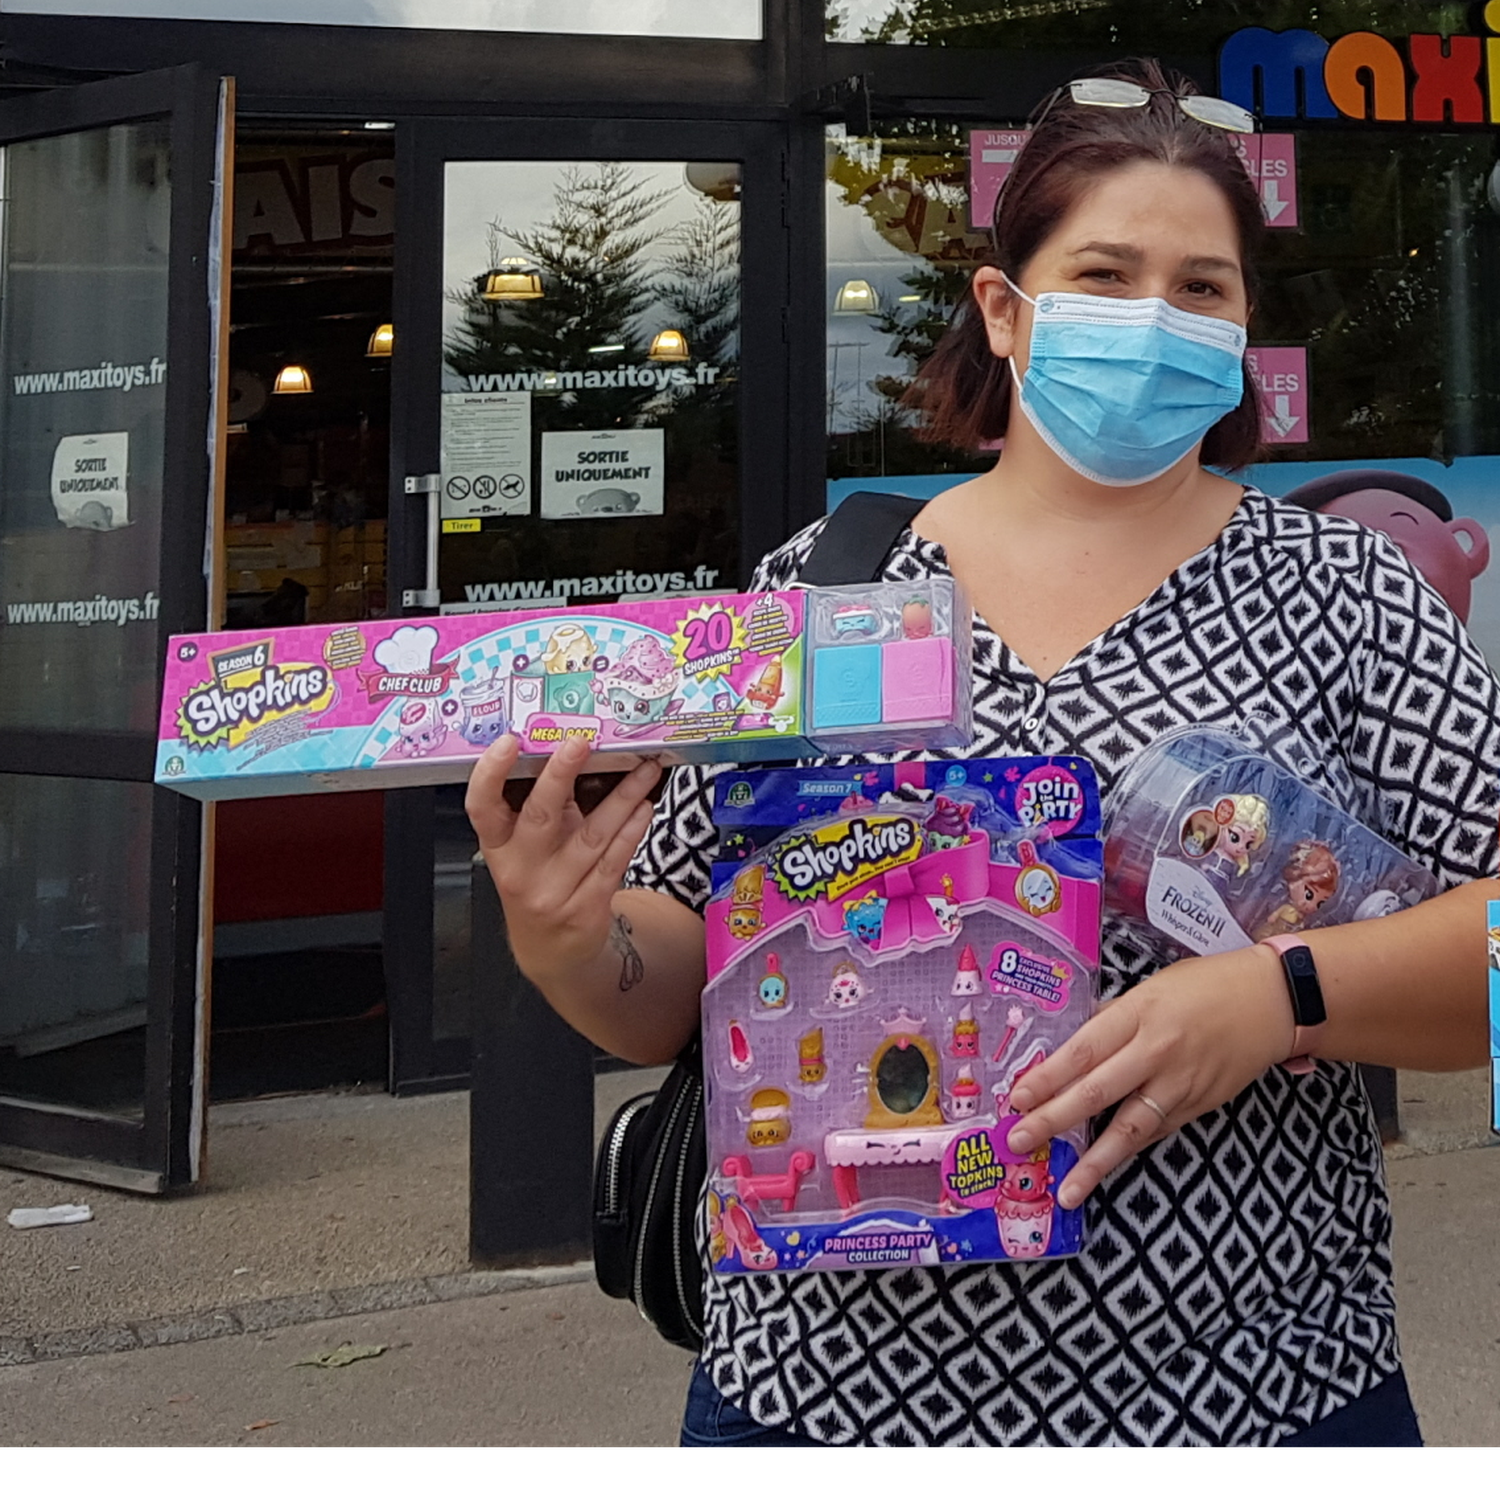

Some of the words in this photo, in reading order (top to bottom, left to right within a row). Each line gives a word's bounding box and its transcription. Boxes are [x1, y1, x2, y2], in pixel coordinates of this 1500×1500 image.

[14, 358, 167, 395] www.maxitoys.fr
[469, 363, 720, 393] www.maxitoys.fr
[74, 457, 107, 473] SORTIE
[577, 451, 629, 465] SORTIE
[554, 466, 652, 483] UNIQUEMENT
[451, 520, 475, 531] Tirer
[464, 565, 719, 602] www.maxitoys.fr
[8, 592, 160, 627] www.maxitoys.fr
[682, 608, 735, 661] 20
[180, 646, 196, 658] 5+
[217, 655, 252, 673] SEASON
[253, 645, 265, 666] 6
[378, 676, 408, 693] CHEF
[409, 675, 442, 692] CLUB
[187, 669, 324, 732] Shopkins
[530, 727, 562, 742] MEGA
[949, 769, 966, 782] 5+
[802, 782, 844, 795] Season
[845, 781, 854, 794] 7
[781, 821, 912, 887] Shopkins
[1001, 949, 1018, 974] 8
[991, 970, 1033, 992] PRINCESS
[1016, 964, 1062, 988] SHOPKINS
[957, 1132, 991, 1160] ALL
[957, 1150, 993, 1175] NEW
[949, 1165, 1004, 1189] TOPKINS
[823, 1234, 888, 1251] PRINCESS
[890, 1232, 933, 1249] PARTY
[848, 1249, 910, 1264] COLLECTION
